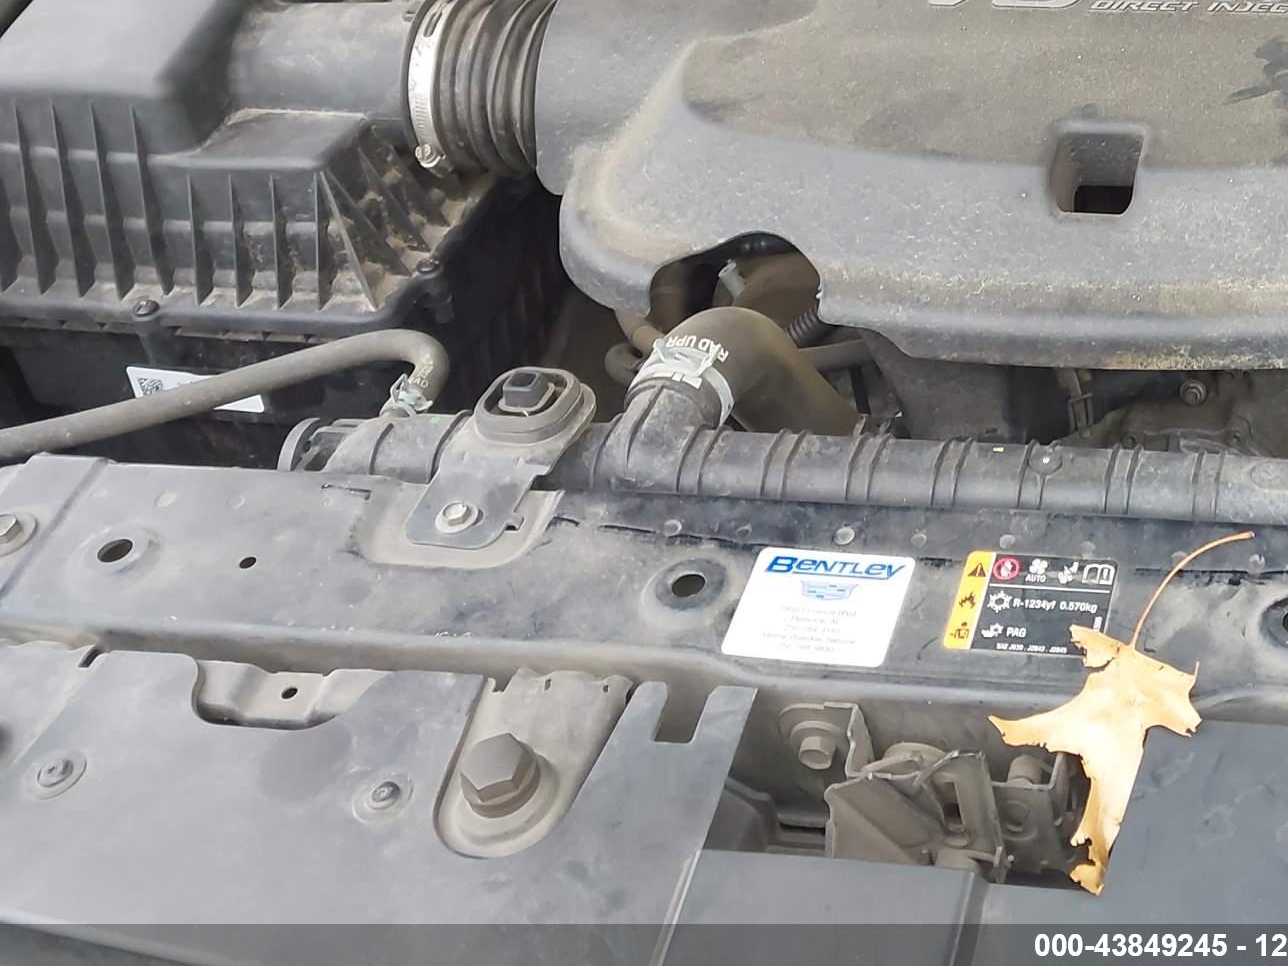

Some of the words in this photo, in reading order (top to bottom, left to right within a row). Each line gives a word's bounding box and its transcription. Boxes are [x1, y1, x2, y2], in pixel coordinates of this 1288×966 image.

[1089, 0, 1199, 13] DIRECT
[666, 335, 697, 348] UPR
[698, 337, 729, 362] RAD
[1025, 574, 1047, 583] AUTO
[1012, 597, 1057, 611] R-1234yf
[1059, 601, 1098, 614] 0.570kg
[1006, 626, 1027, 638] PAG
